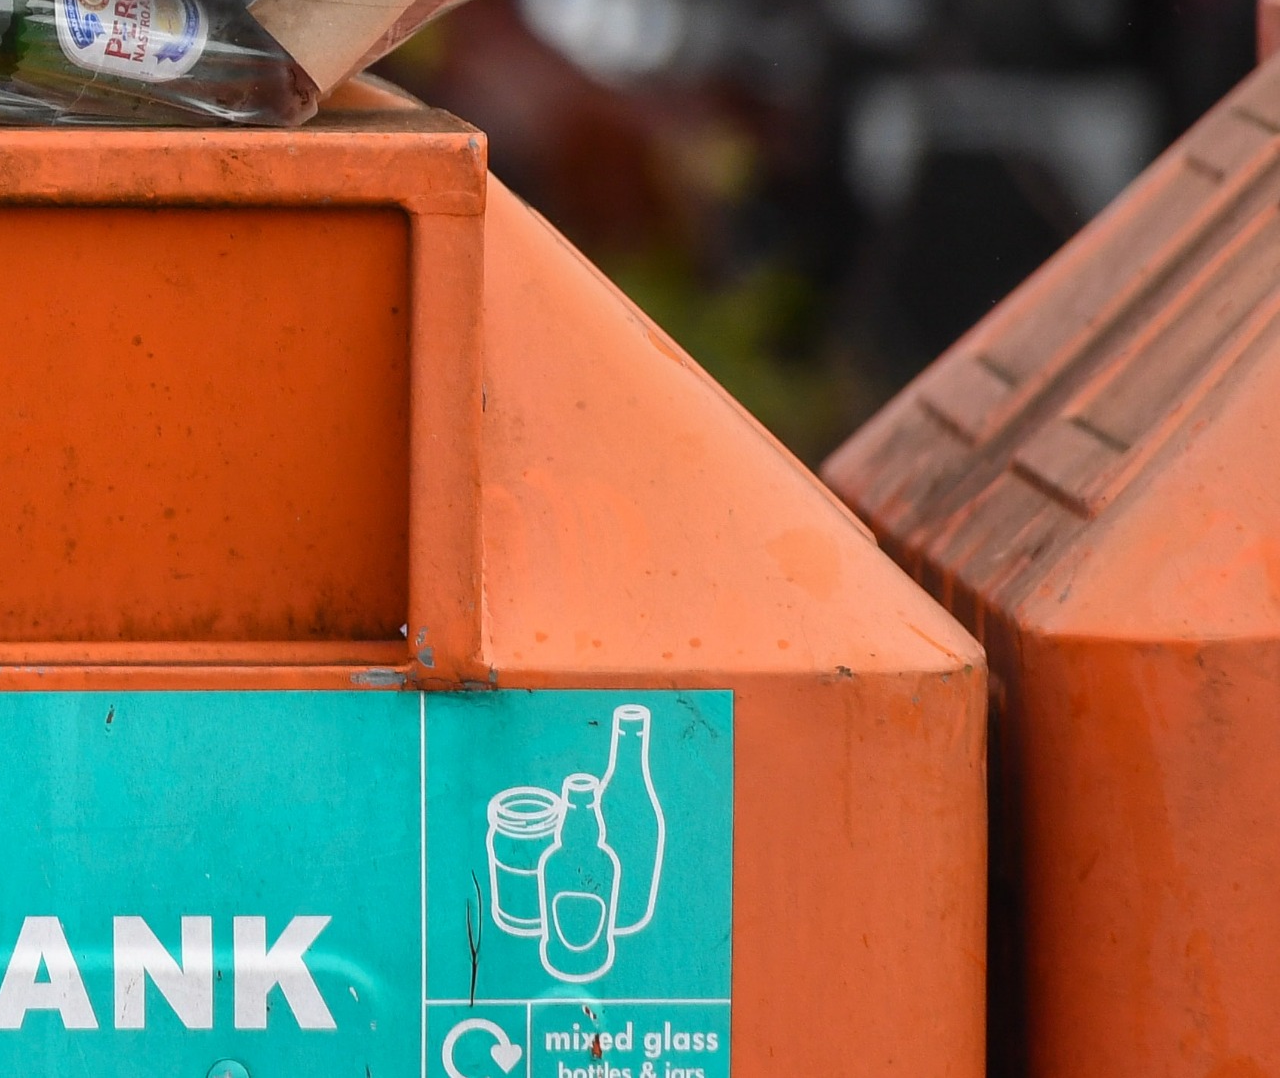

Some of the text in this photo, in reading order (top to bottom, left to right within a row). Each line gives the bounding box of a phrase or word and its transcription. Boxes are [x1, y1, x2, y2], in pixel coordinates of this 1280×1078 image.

[131, 9, 151, 63] NASTRO
[545, 1021, 719, 1058] mixed glass
